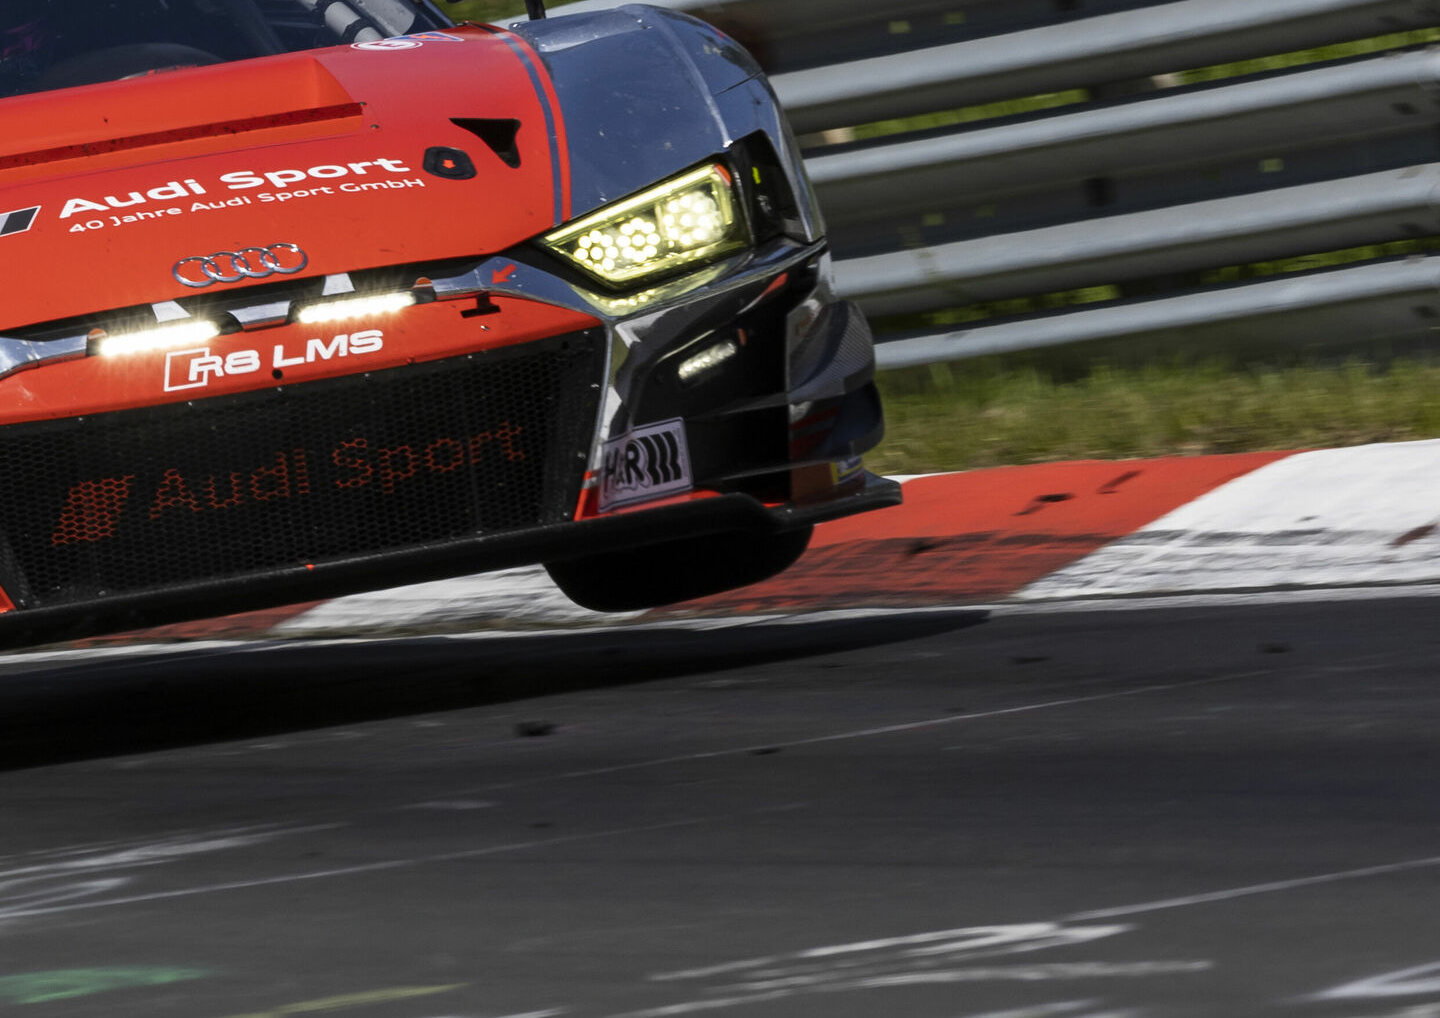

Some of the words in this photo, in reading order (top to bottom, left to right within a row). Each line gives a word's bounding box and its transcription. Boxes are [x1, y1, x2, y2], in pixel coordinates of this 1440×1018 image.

[59, 179, 207, 219] Audi
[219, 158, 411, 189] Sport
[69, 220, 104, 233] 40
[110, 207, 182, 226] Jahre
[191, 196, 252, 212] Audi
[257, 186, 335, 203] Sport
[339, 178, 425, 193] GmbH
[188, 348, 261, 381] R8
[273, 330, 383, 369] LMS
[150, 447, 310, 520] Audi
[332, 422, 527, 494] Sport
